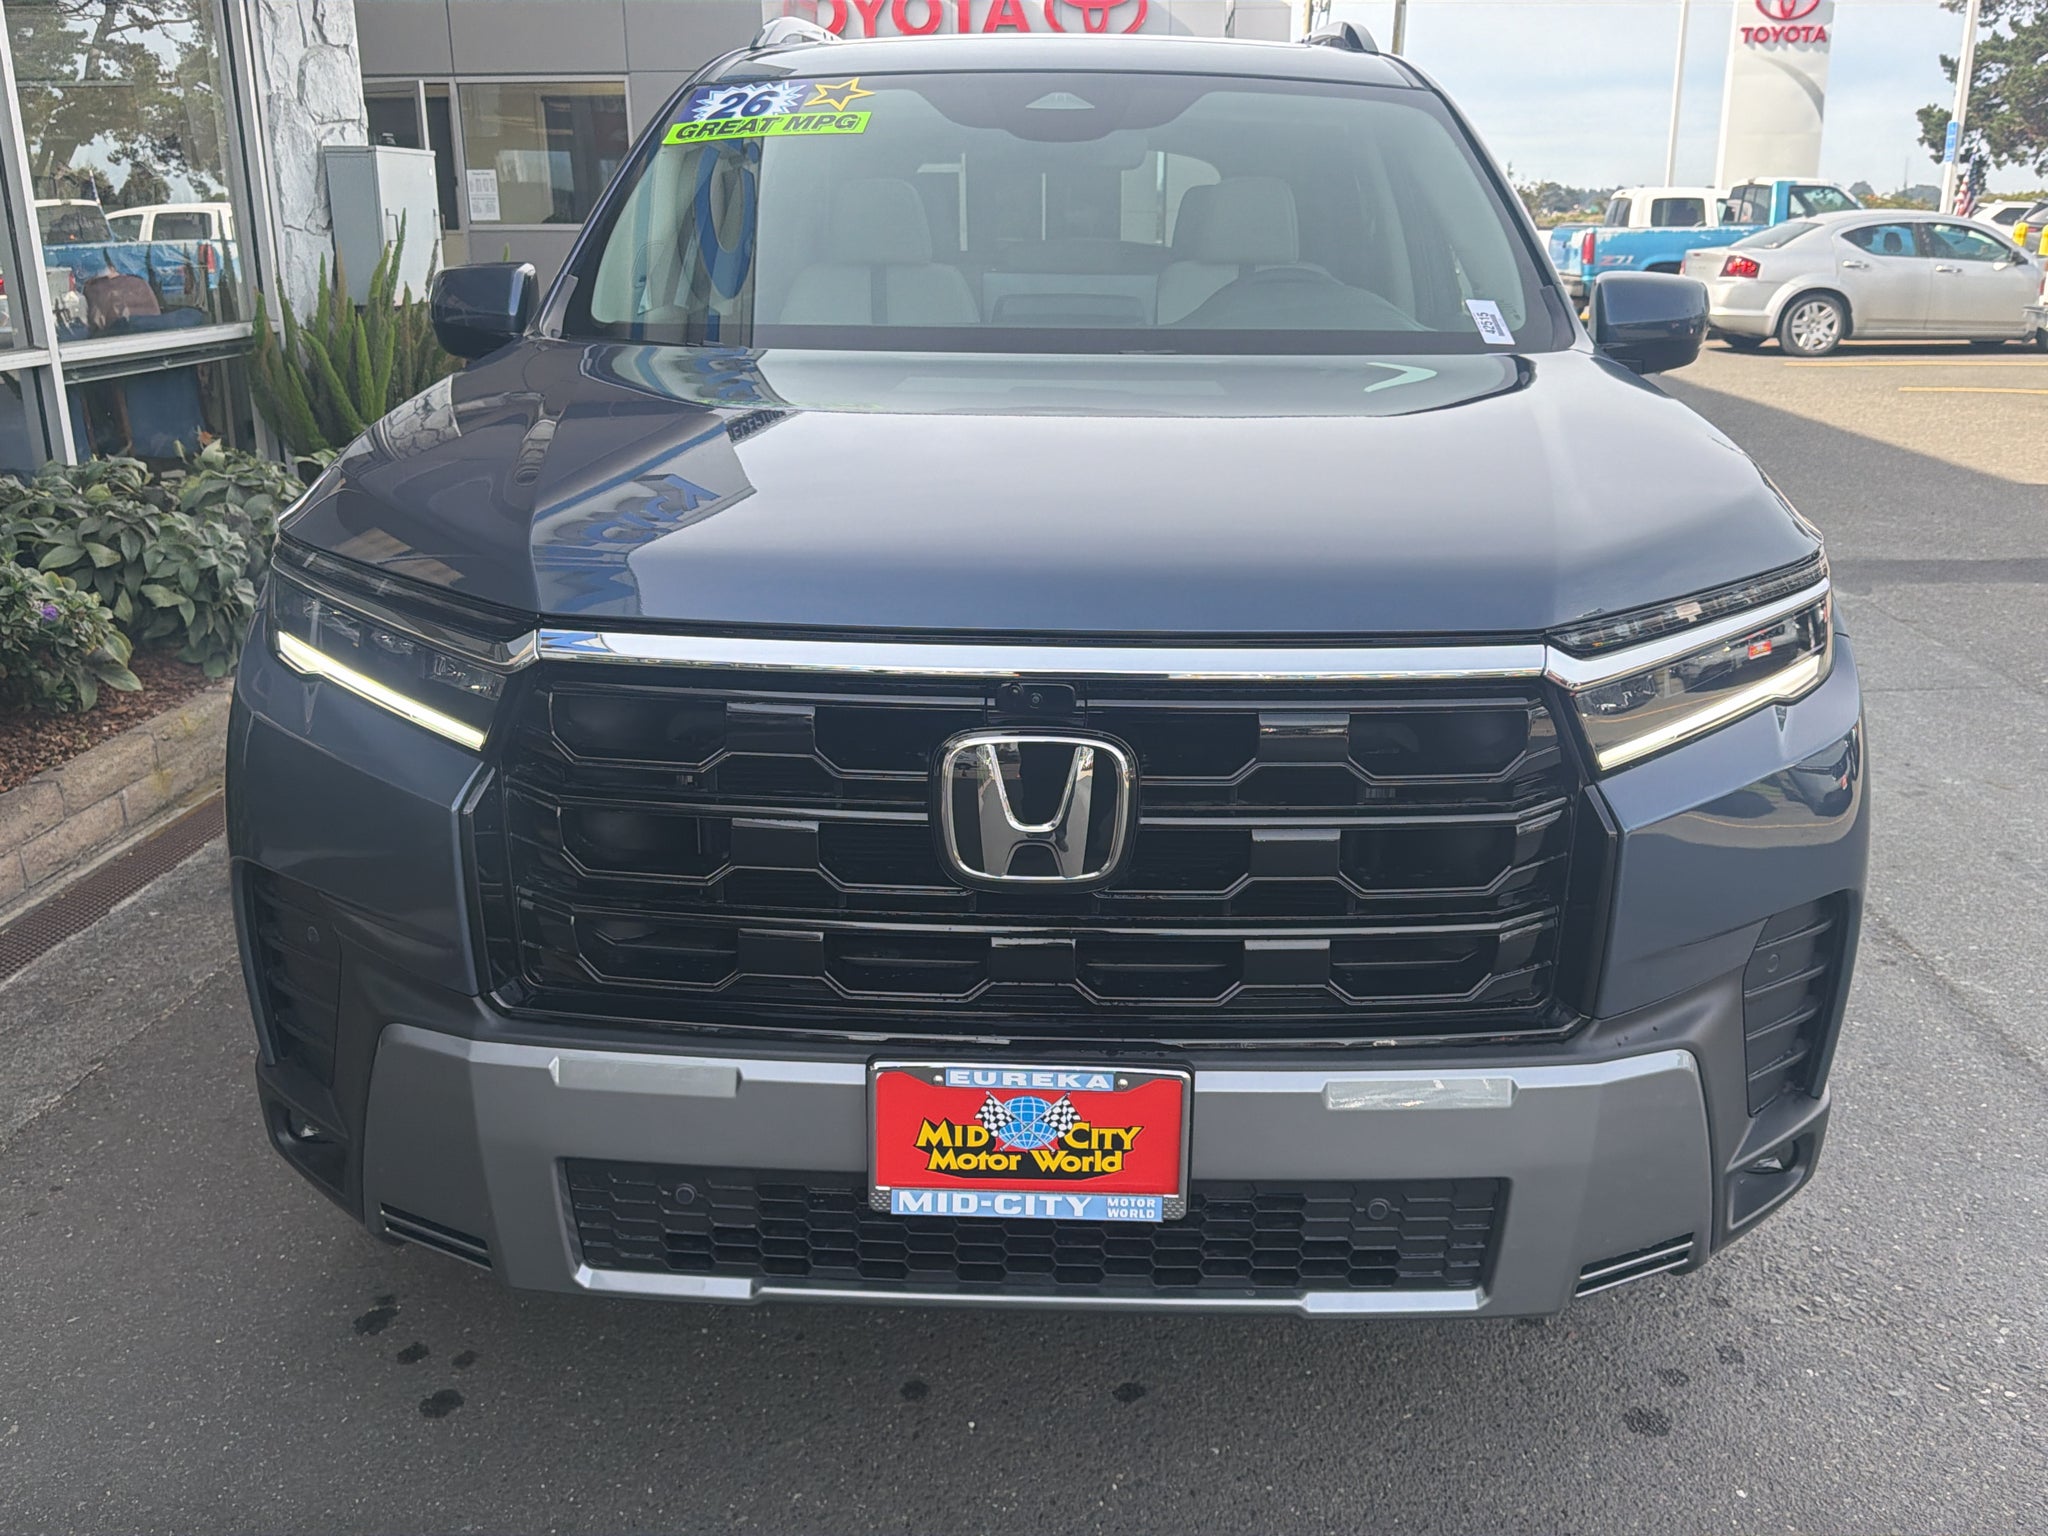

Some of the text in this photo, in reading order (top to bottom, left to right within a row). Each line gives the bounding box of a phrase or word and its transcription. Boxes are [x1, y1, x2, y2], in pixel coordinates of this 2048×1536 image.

[1741, 26, 1827, 43] TOYOTA
[709, 90, 780, 119] 26
[676, 114, 860, 140] GREAT MPG
[1600, 255, 1635, 266] Z71
[1476, 312, 1496, 334] 42515
[949, 1071, 1110, 1089] EUREKA
[915, 1119, 1143, 1150] MID CITY
[927, 1148, 1123, 1173] Motor World
[898, 1191, 1092, 1217] MID-CITY
[1107, 1197, 1156, 1208] MOTOR
[1107, 1208, 1155, 1219] WORLD
